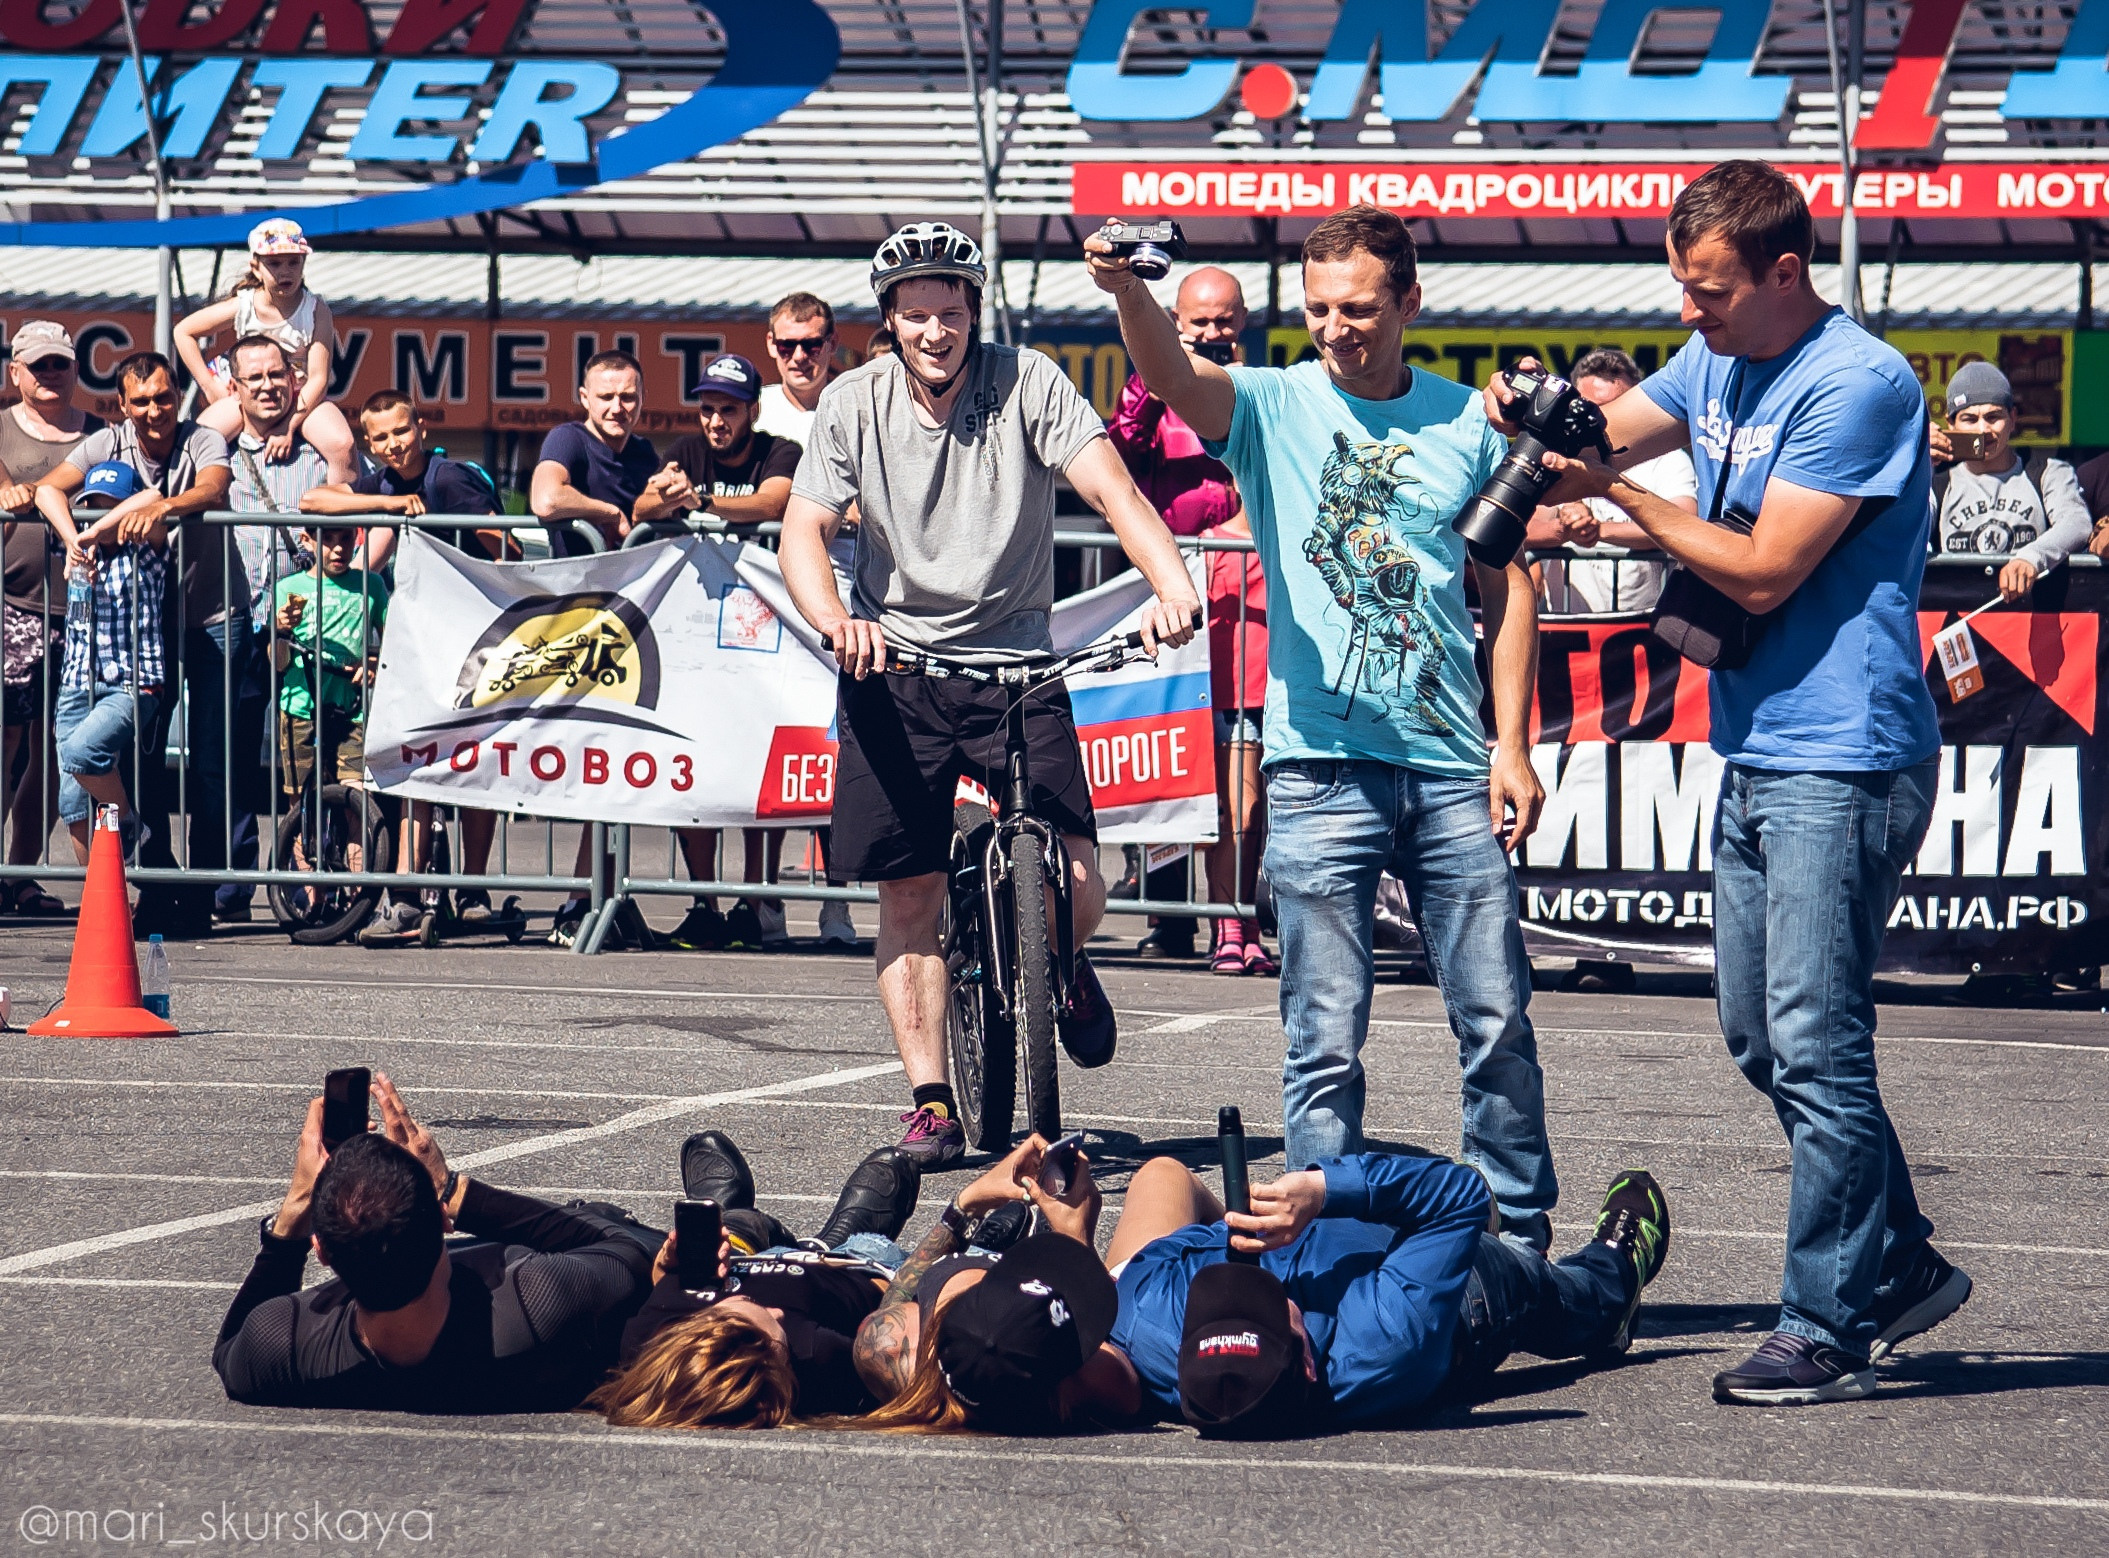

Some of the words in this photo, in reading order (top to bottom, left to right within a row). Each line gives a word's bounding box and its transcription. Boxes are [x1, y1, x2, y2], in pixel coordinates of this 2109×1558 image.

[1122, 171, 1335, 213] МОПЕДЫ
[1787, 172, 1962, 208] УТЕРЫ
[1997, 174, 2109, 208] МОТ
[401, 740, 694, 792] МОТОВОЗ
[1199, 1331, 1258, 1351] gymkhana
